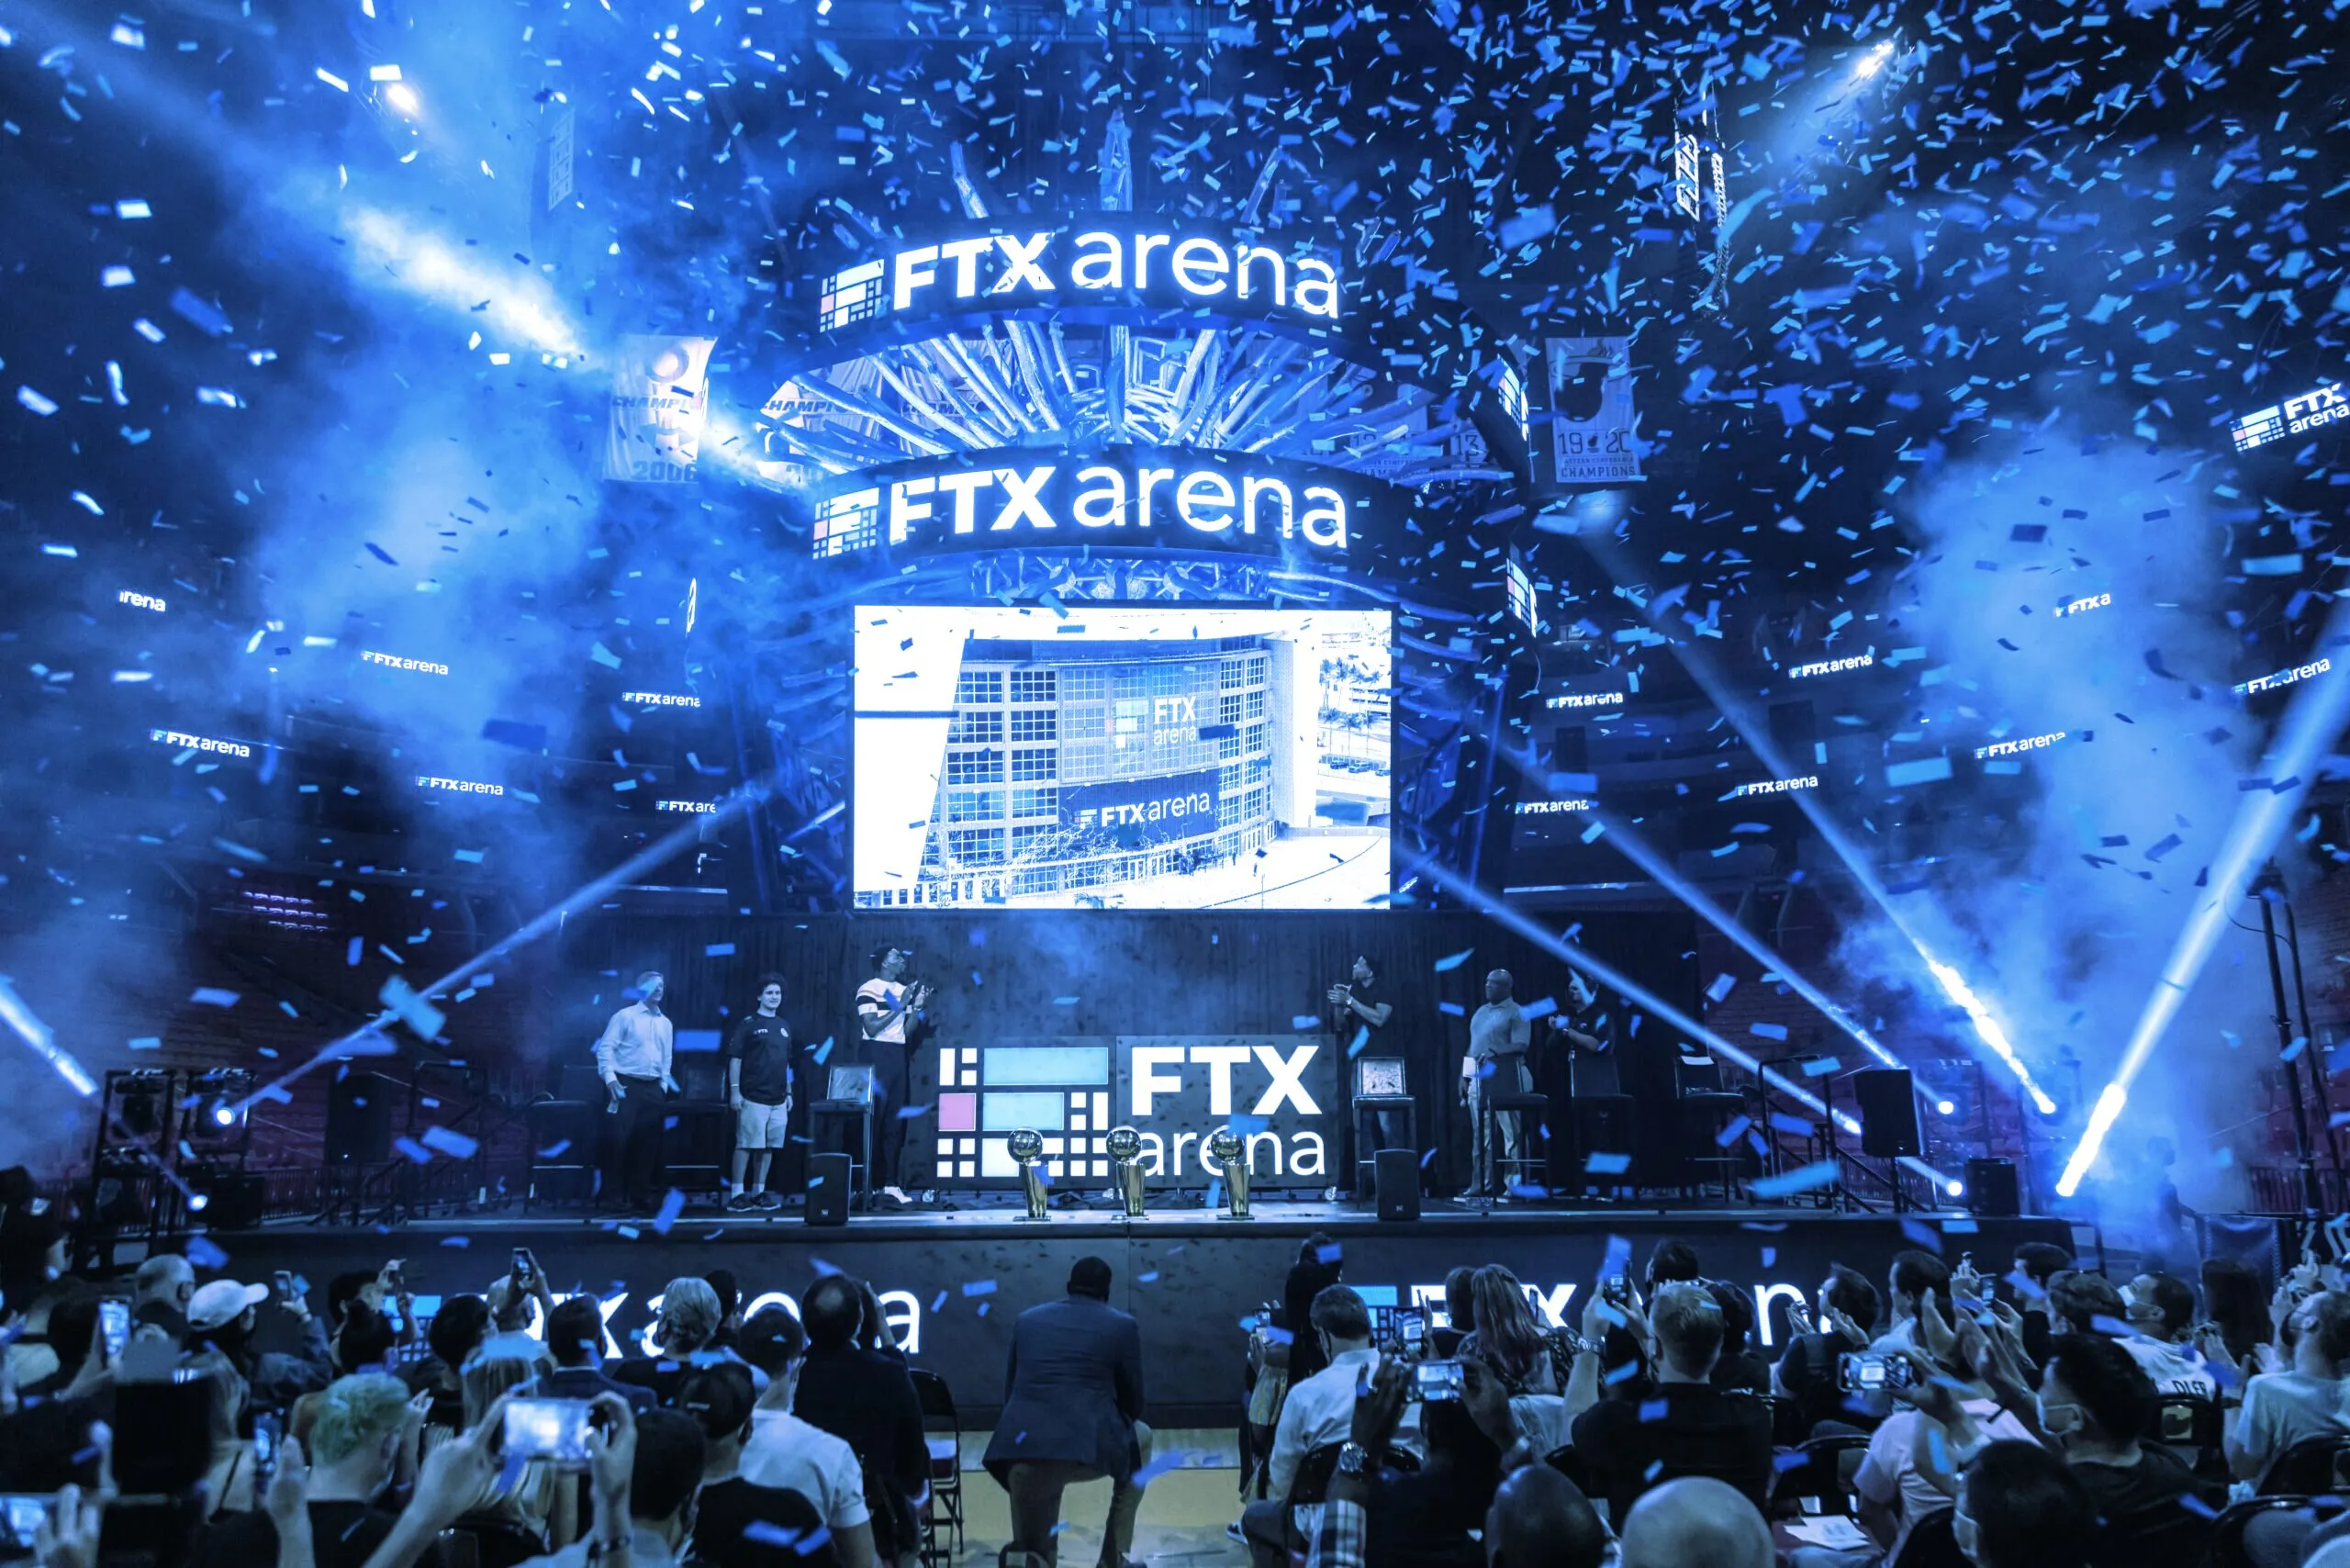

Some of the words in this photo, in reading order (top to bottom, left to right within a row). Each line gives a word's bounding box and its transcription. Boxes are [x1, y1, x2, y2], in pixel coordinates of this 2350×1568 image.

[893, 231, 1057, 311] FTX
[1070, 230, 1339, 319] arena
[2283, 382, 2347, 420] FTX
[2288, 403, 2350, 434] arena
[1558, 431, 1584, 454] 19
[1561, 465, 1636, 478] CHAMPIONS
[890, 466, 1057, 546] FTX
[1073, 466, 1348, 548] arena
[119, 590, 166, 612] rena
[2067, 595, 2100, 614] FTX
[374, 652, 402, 668] FTX
[402, 658, 450, 676] arena
[1801, 662, 1830, 677] FTX
[1830, 655, 1874, 671] arena
[635, 691, 662, 704] FTX
[1558, 695, 1583, 709] FTX
[1583, 692, 1624, 706] arena
[1154, 696, 1197, 724] FTX
[166, 731, 200, 748] FTX
[200, 738, 251, 758] arena
[1154, 727, 1197, 745] arena
[1987, 740, 2019, 757] FTX
[430, 777, 459, 790] FTX
[459, 780, 504, 796] arena
[1747, 780, 1775, 796] FTX
[1775, 776, 1819, 791] arena
[668, 801, 695, 812] FTX
[695, 801, 717, 813] are
[1101, 802, 1147, 827] FTX
[1147, 792, 1211, 821] arena
[1524, 801, 1550, 814] FTX
[1131, 1045, 1323, 1117] FTX
